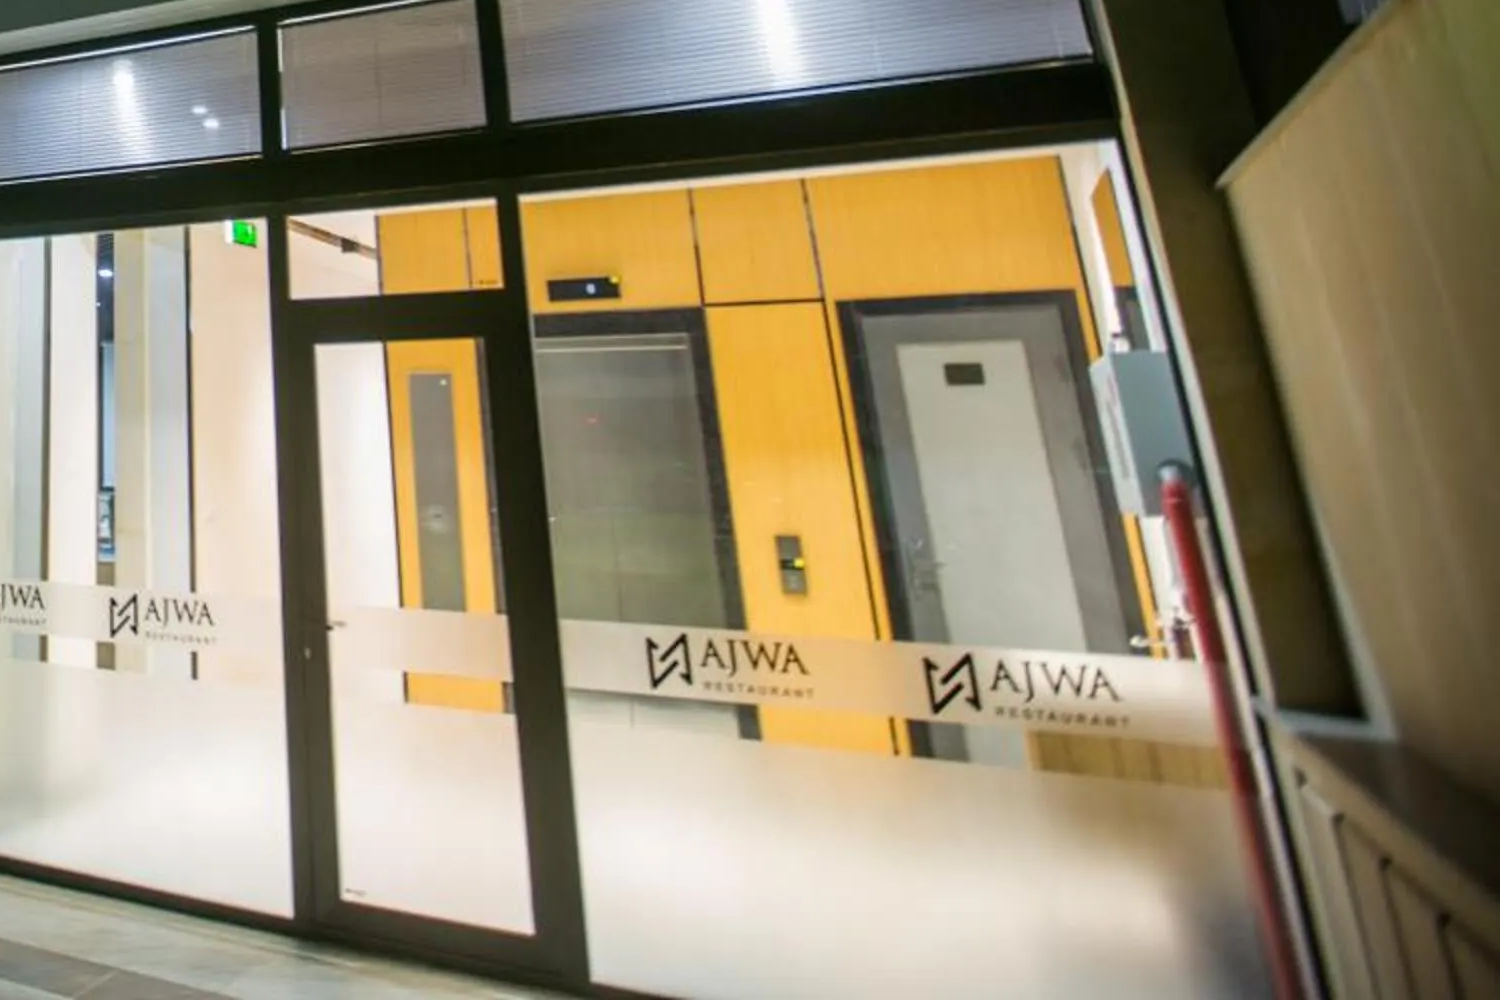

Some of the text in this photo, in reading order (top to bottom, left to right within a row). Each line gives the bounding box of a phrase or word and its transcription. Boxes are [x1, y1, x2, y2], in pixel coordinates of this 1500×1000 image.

[144, 598, 215, 628] AJWA
[700, 638, 811, 678] AJWA
[702, 680, 814, 698] RESTAURANT
[990, 658, 1123, 702] AJWA
[995, 705, 1130, 727] RESTAURANT
